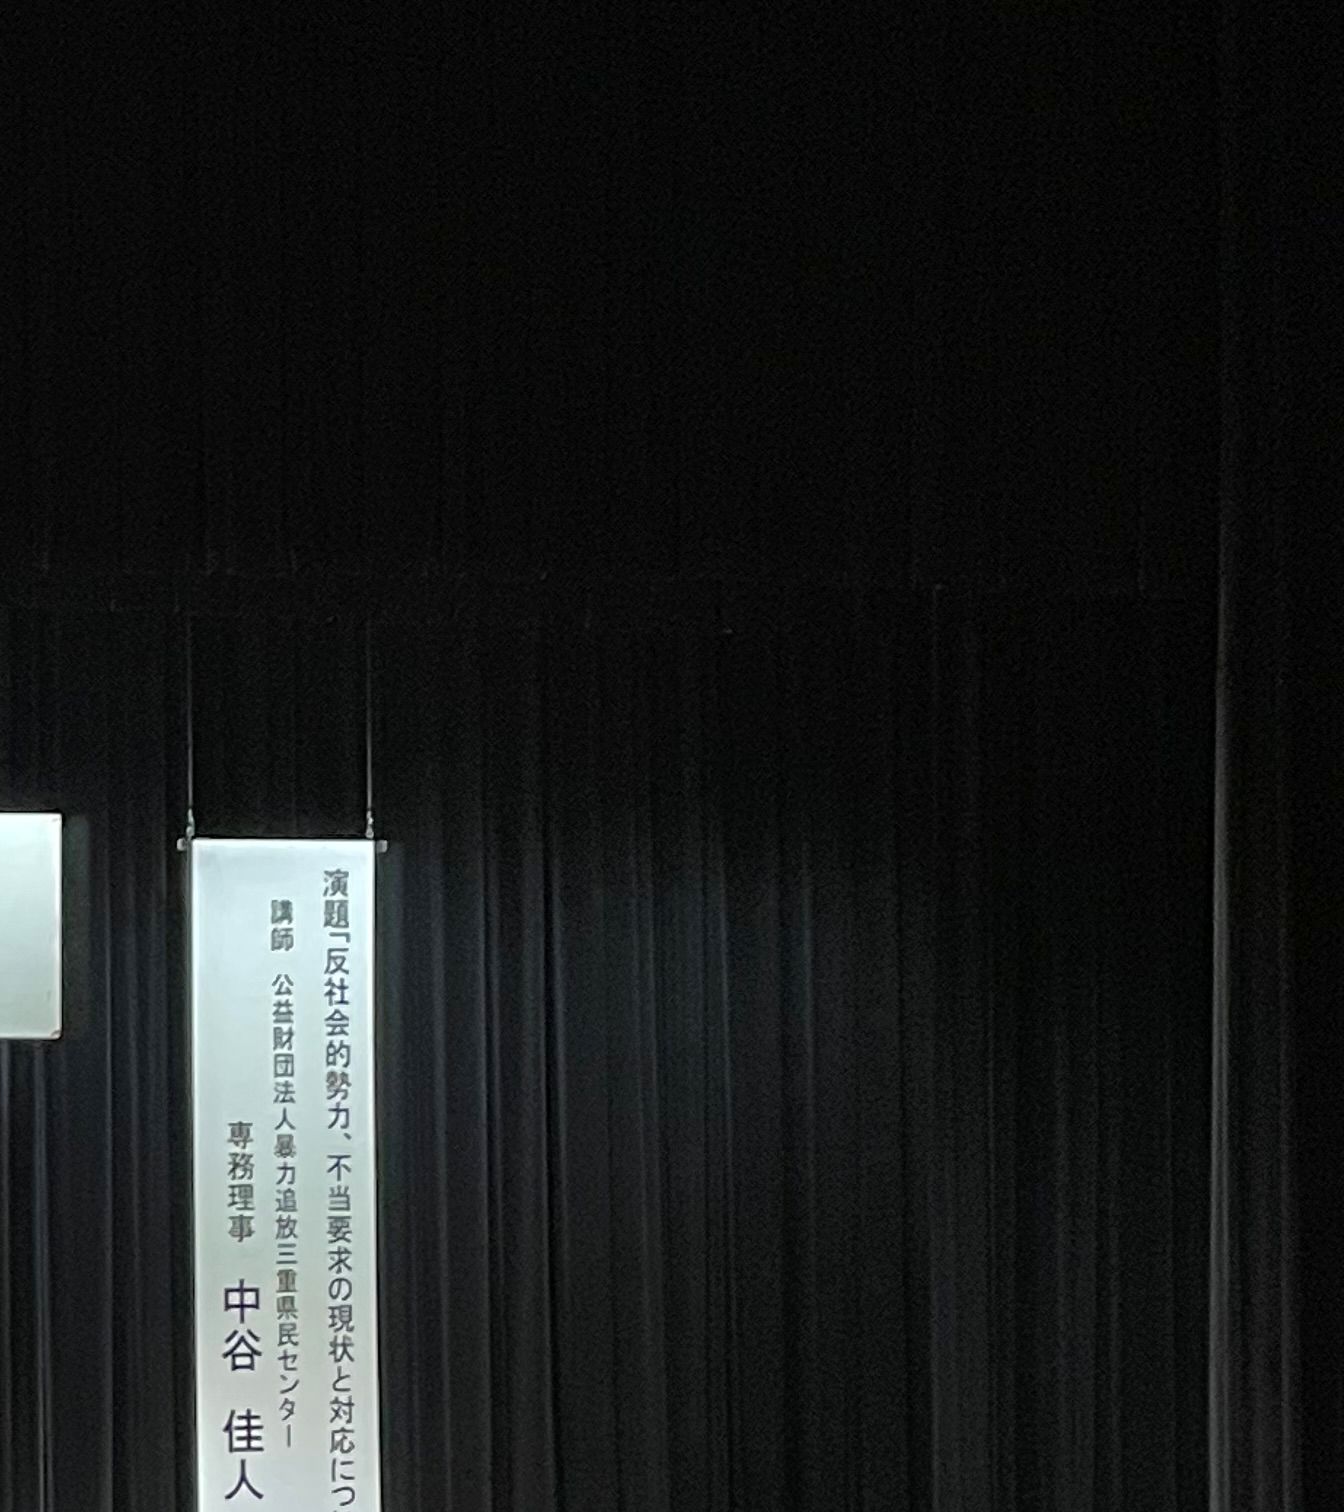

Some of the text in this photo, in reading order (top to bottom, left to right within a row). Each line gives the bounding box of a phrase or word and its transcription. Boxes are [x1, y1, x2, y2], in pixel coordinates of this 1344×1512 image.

[226, 1121, 256, 1243] 専務理事
[270, 899, 300, 1448] 講師 公益財団法人暴力追放三重県民センター
[221, 1278, 263, 1372] 中谷
[222, 1408, 265, 1501] 佳人
